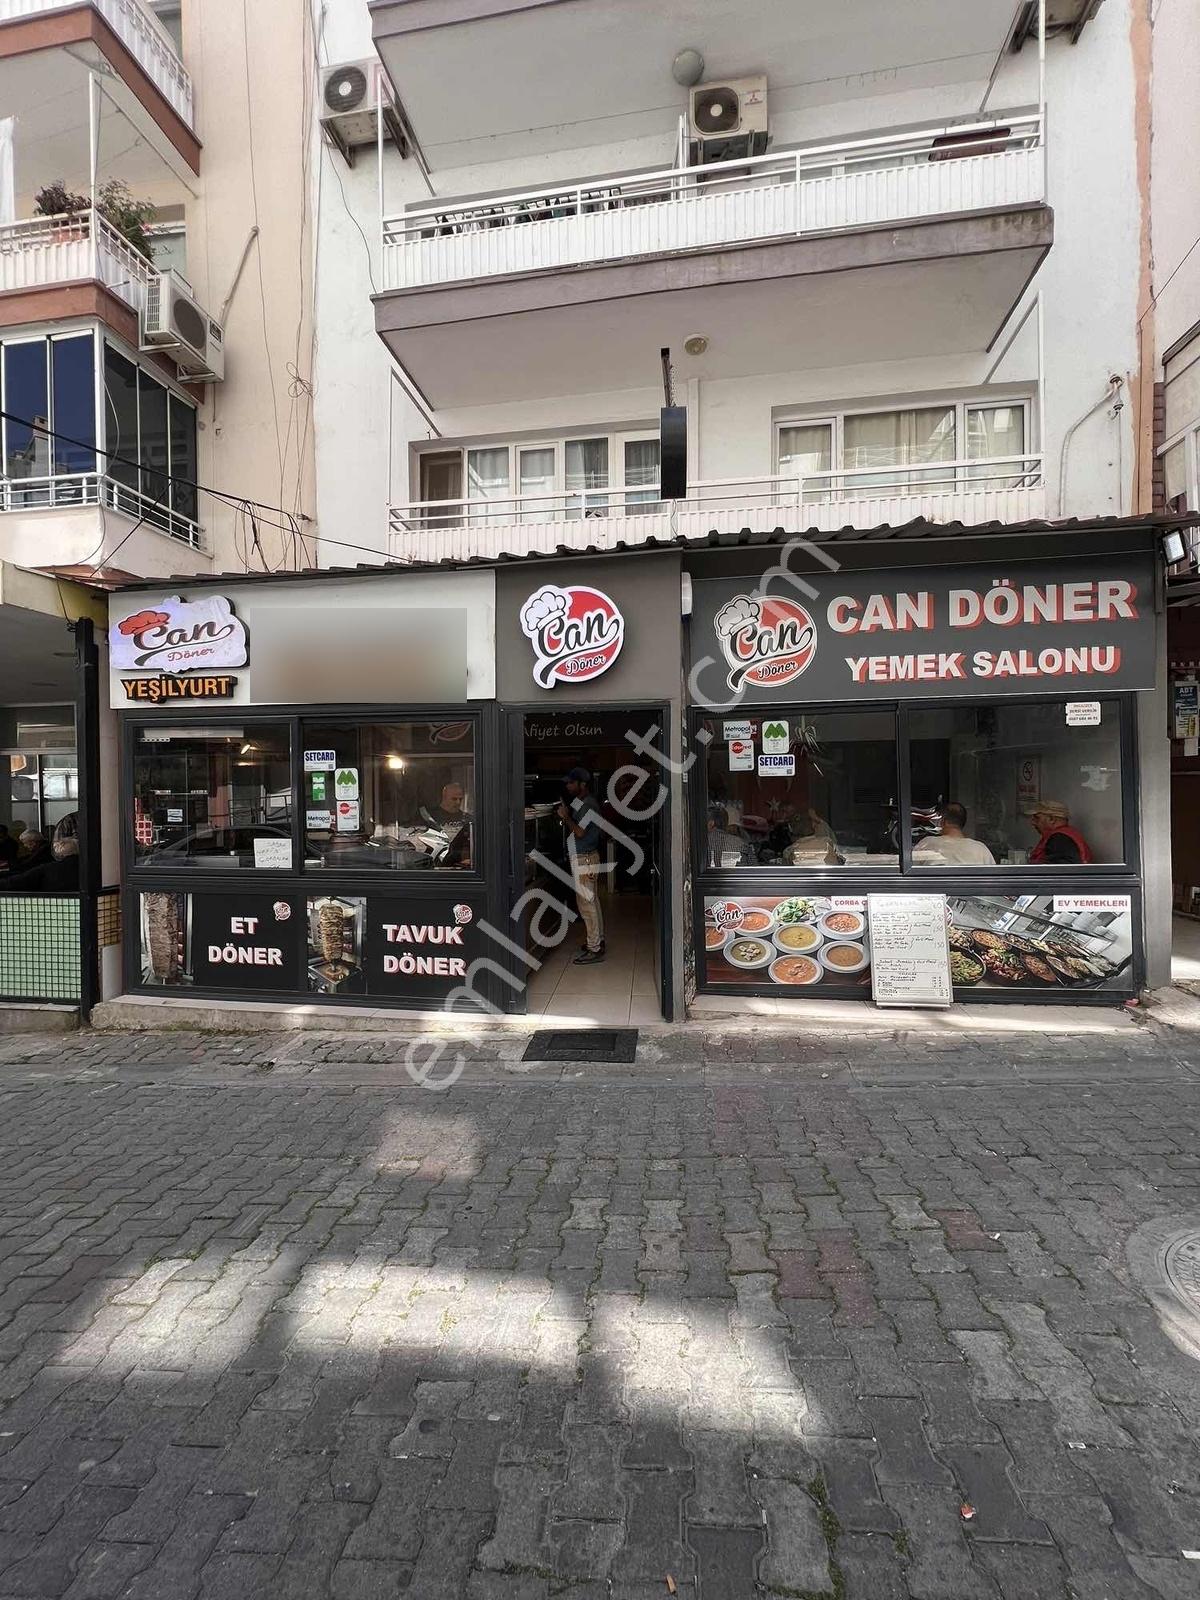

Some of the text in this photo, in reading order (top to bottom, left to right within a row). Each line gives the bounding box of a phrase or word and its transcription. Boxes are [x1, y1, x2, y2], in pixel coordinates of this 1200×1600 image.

[826, 578, 1138, 635] CAN DÖNER
[134, 619, 234, 651] Can
[537, 613, 619, 659] Can
[731, 620, 813, 661] Can
[167, 646, 215, 664] Döner
[566, 654, 607, 676] Döner
[845, 645, 1122, 683] YEMEK SALONU
[757, 661, 798, 679] Döner
[124, 675, 231, 701] YEŞİLYURT
[565, 723, 602, 736] Olsun
[305, 751, 334, 762] SETCARD
[760, 756, 794, 766] SETCARD
[834, 899, 860, 907] ÇORBA
[1073, 899, 1128, 907] YEMEKLERİ
[717, 908, 743, 921] Can
[230, 916, 260, 936] ET
[382, 924, 464, 945] TAVUK
[207, 943, 284, 966] DÖNER
[382, 951, 469, 976] DÖNER
